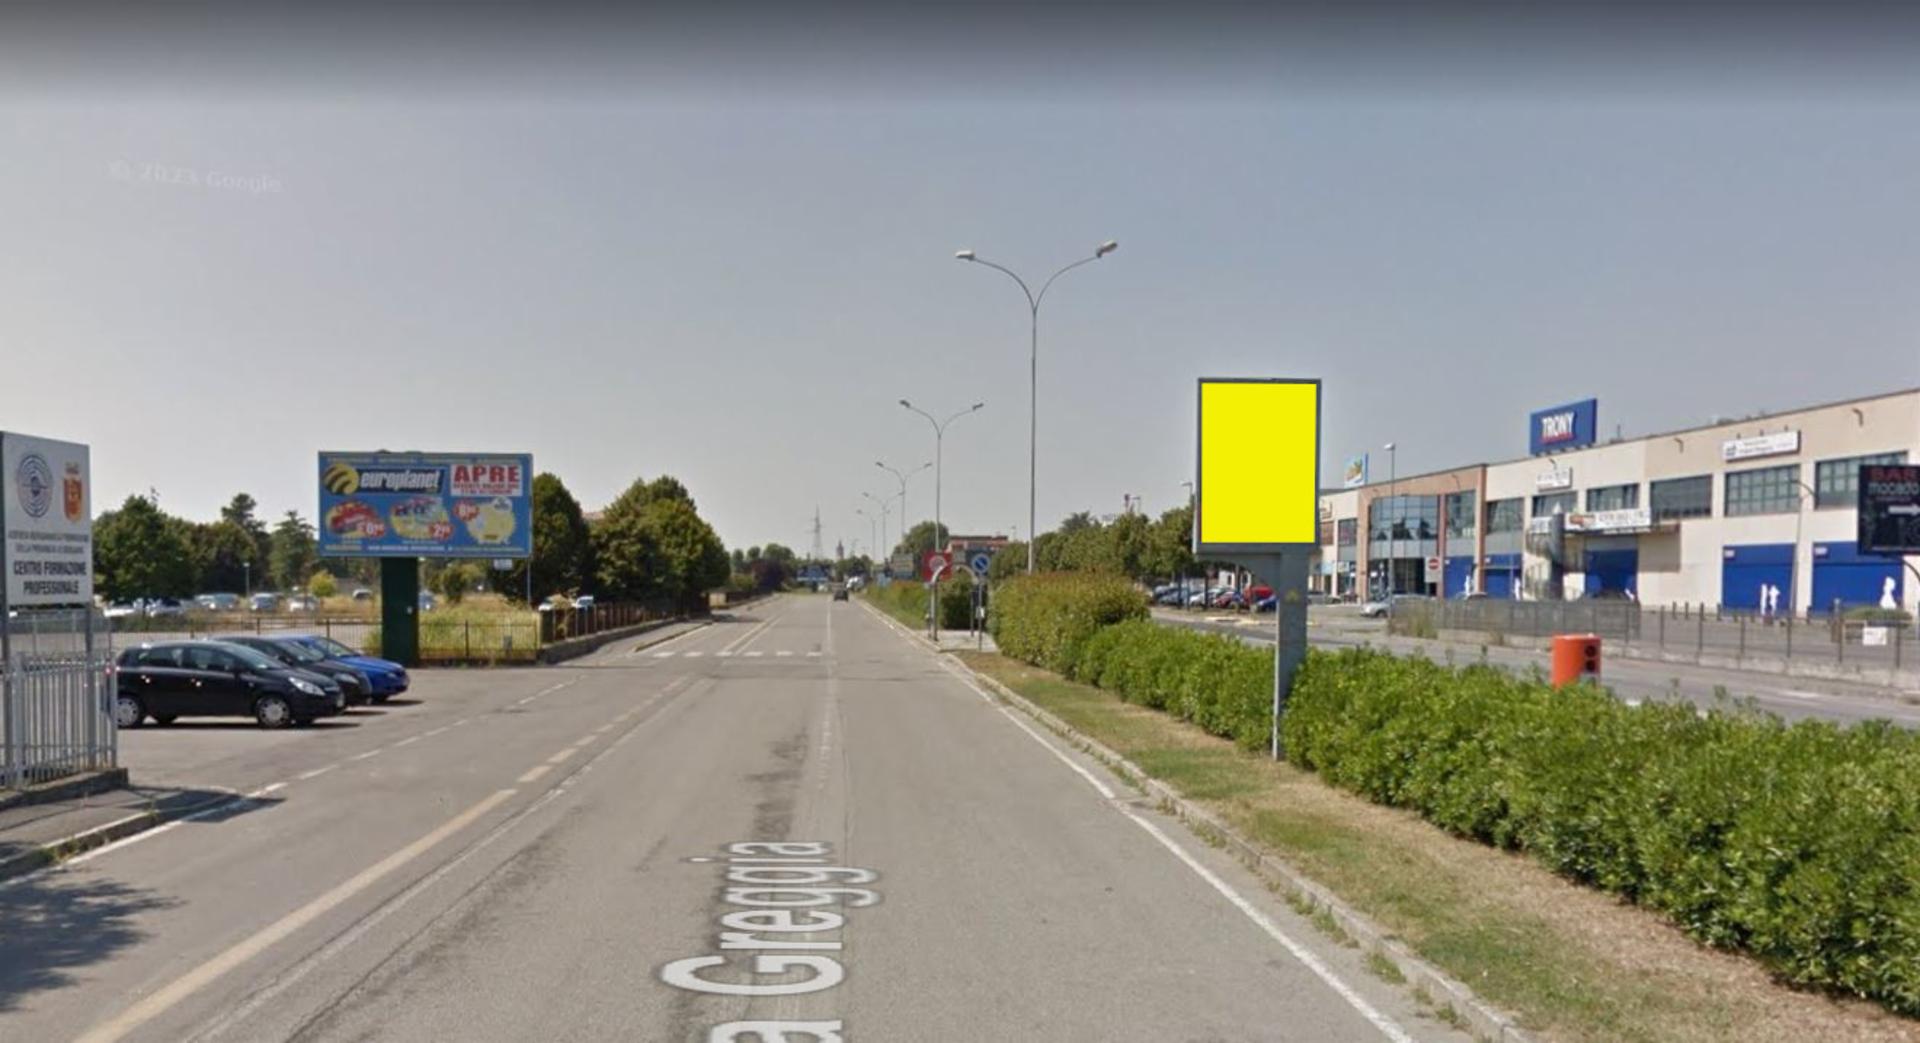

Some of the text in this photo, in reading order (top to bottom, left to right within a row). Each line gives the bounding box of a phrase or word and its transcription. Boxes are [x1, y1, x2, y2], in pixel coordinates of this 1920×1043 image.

[1541, 411, 1574, 438] TRONY
[360, 470, 440, 491] europlanet
[454, 465, 520, 483] APRE
[1870, 467, 1916, 480] BAR
[14, 560, 86, 575] CENTRO FORMAZIONE
[23, 580, 79, 595] PROFESSIONALE
